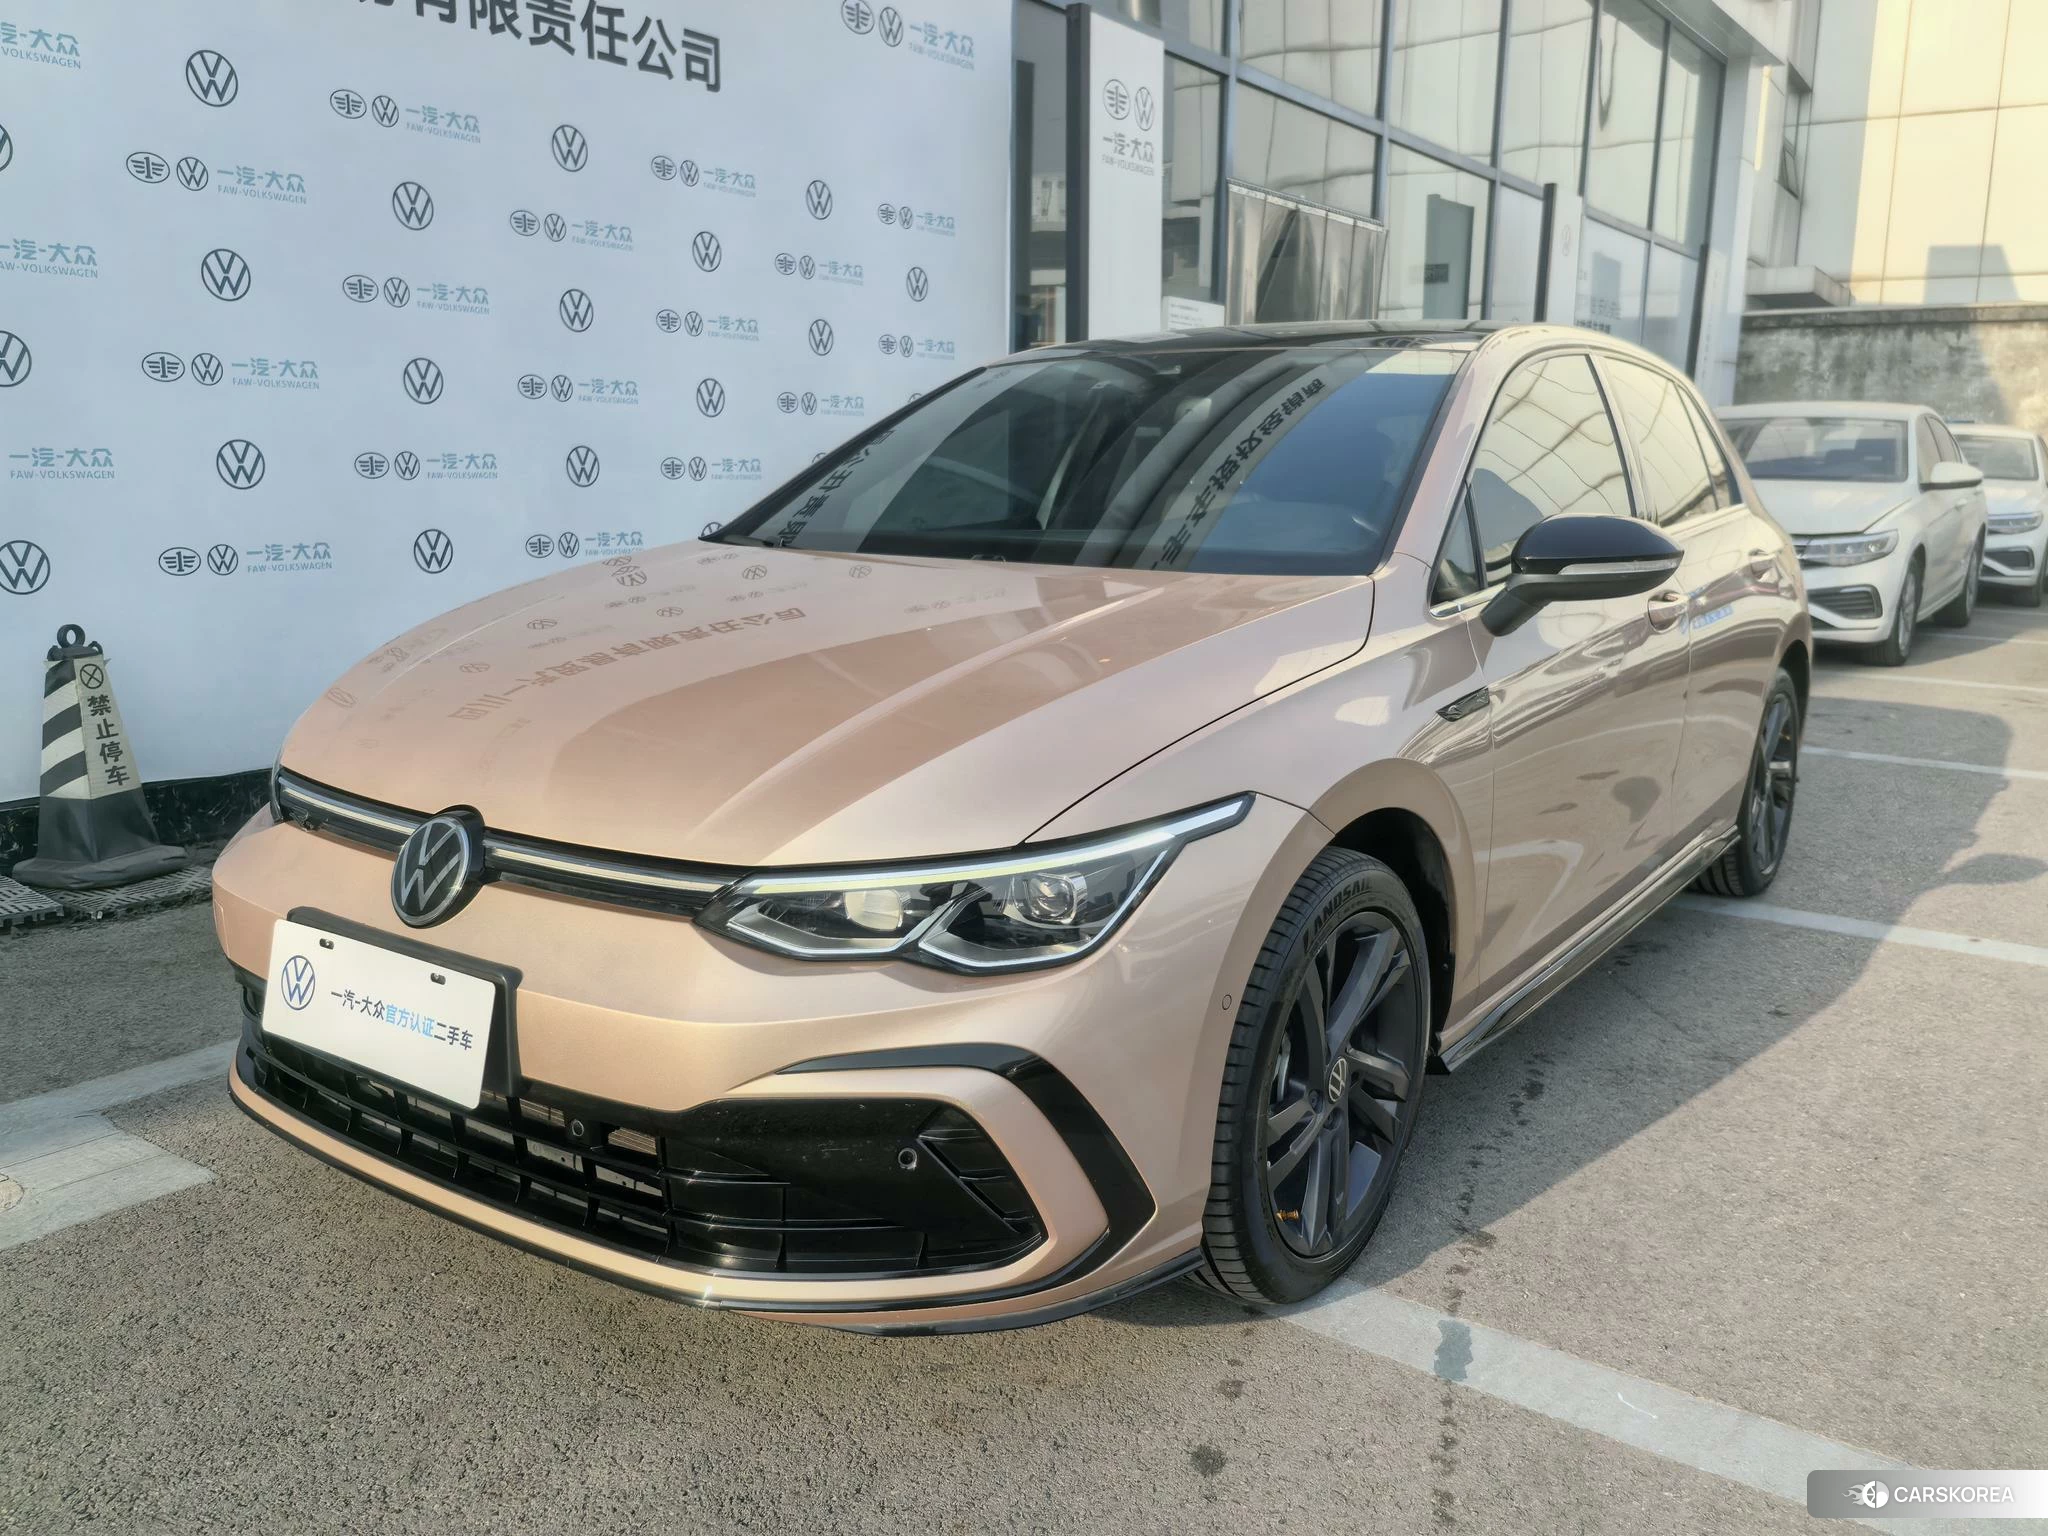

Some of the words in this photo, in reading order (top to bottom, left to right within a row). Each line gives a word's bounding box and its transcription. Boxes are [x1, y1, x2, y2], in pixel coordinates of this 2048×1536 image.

[359, 0, 720, 92] 限责任公司
[406, 105, 480, 133] 一汽-大众
[406, 123, 481, 143] FAW-VOLKSWAGEN
[217, 165, 306, 194] 一汽-大众
[217, 185, 307, 205] FAW-VOLKSWAGEN
[417, 284, 489, 305] 一汽-大众
[232, 358, 318, 379] 一汽-大众
[232, 377, 320, 390] FAW-VOLKSWAGEN
[9, 448, 114, 468] 一汽-大众
[426, 453, 498, 470] 一汽-大众
[10, 470, 115, 479] FAW-VOLKSWAGEN
[246, 543, 331, 561] 一汽-大众
[247, 562, 332, 573] FAW-VOLKSWAGEN
[87, 694, 130, 786] 禁止停车
[330, 989, 473, 1051] 一汽-大众官方认证二手车
